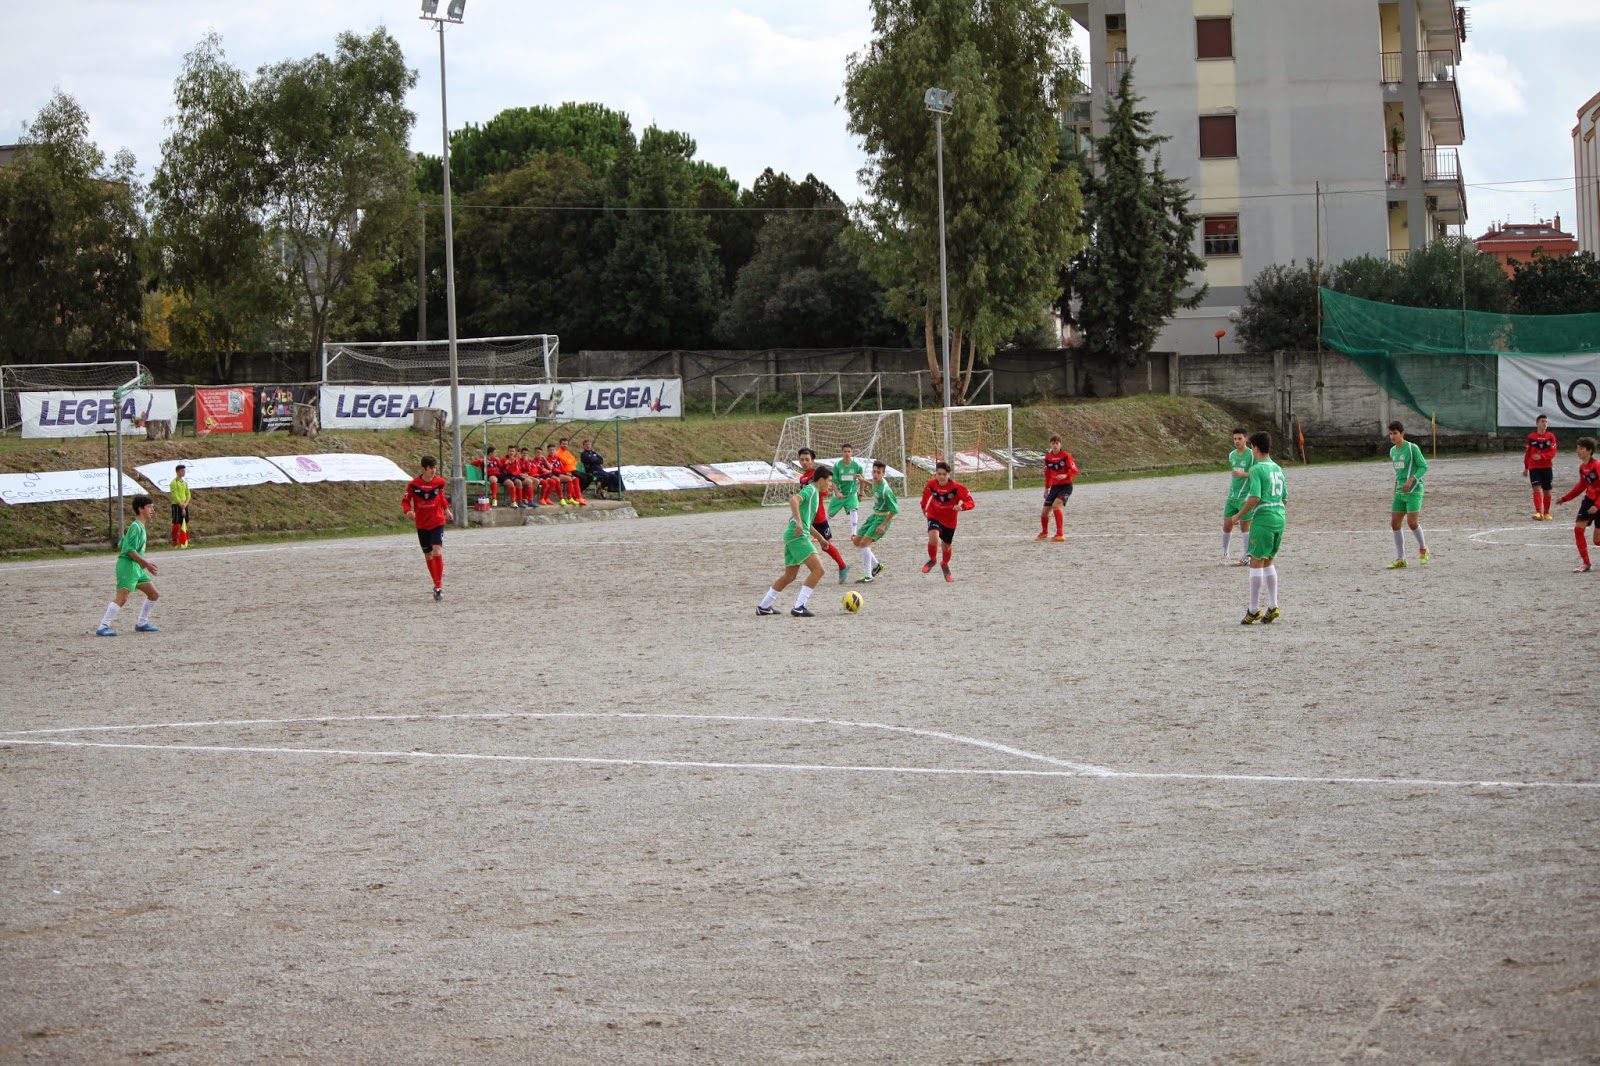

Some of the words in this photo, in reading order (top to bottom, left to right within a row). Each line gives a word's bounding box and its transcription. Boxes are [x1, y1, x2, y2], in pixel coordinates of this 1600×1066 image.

[336, 394, 419, 418] LEGEA
[467, 392, 541, 416] LEGEA
[584, 386, 651, 411] LEGEA
[39, 398, 136, 427] LEGEA
[1270, 471, 1284, 497] 15
